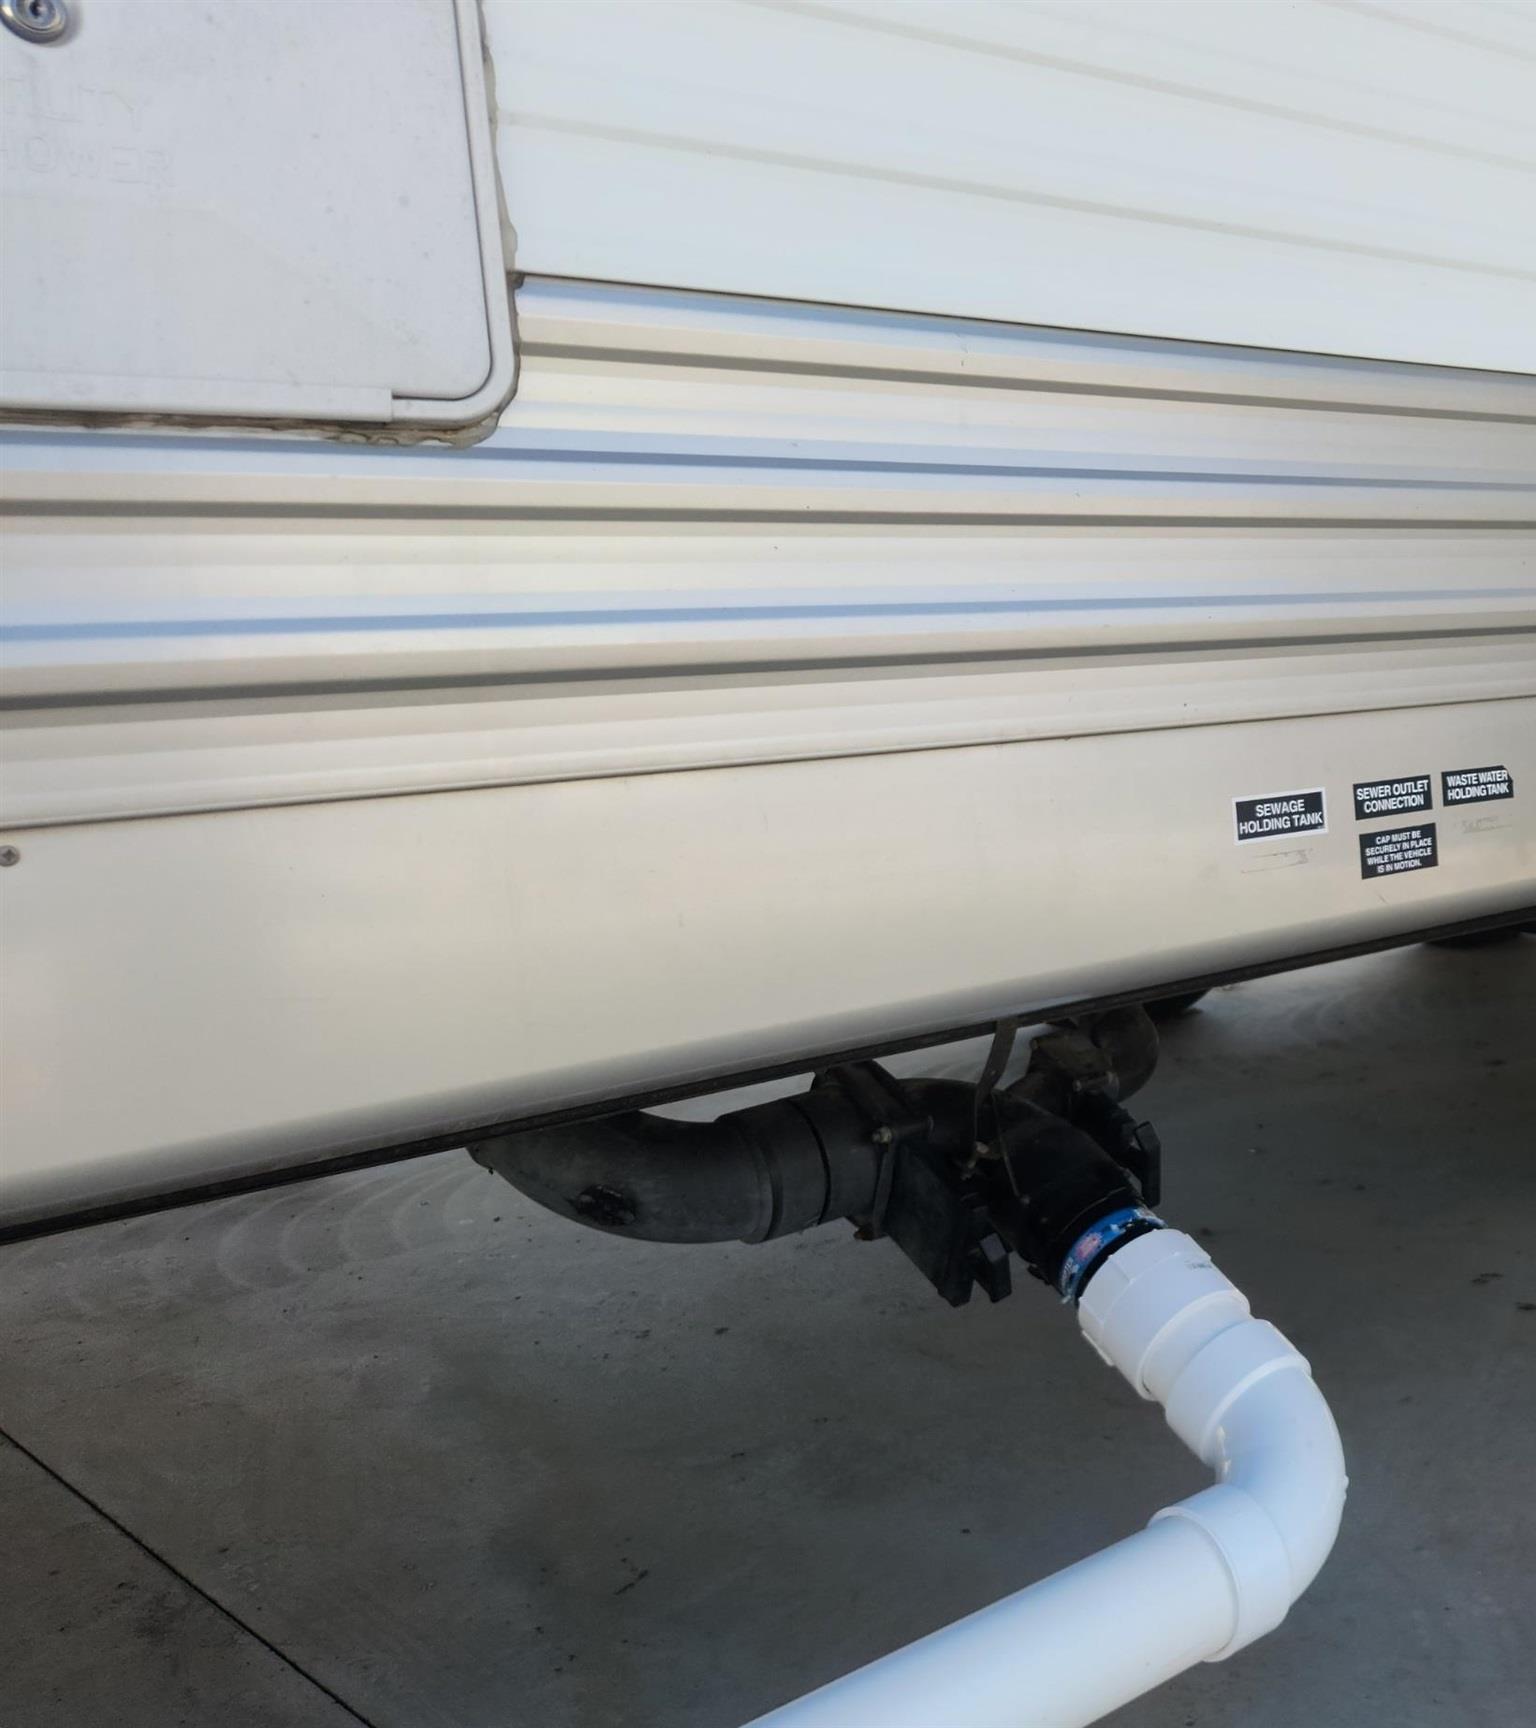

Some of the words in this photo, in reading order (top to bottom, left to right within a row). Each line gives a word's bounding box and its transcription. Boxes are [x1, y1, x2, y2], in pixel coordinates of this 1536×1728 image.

[1446, 773, 1478, 787] WASTE
[1478, 769, 1508, 784] WATER
[1356, 785, 1391, 800] SEWER
[1392, 780, 1429, 796] OUTLET
[1447, 785, 1486, 800] HOLDING
[1486, 782, 1509, 796] TANK
[1256, 799, 1305, 817] SEWAGE
[1364, 794, 1424, 813] CONNECTION
[1239, 816, 1291, 834] HOLDING
[1292, 812, 1323, 827] TANK
[1376, 835, 1391, 844] CAP
[1391, 832, 1410, 842] MUST
[1411, 830, 1421, 839] BE
[1365, 843, 1402, 856] SECURELY
[1402, 841, 1409, 849] IN
[1410, 837, 1433, 849] PLACE
[1367, 854, 1389, 865] WHILE
[1390, 851, 1403, 861] THE
[1403, 847, 1432, 859] VEHICLE
[1377, 865, 1385, 873] IS
[1386, 863, 1393, 871] IN
[1394, 859, 1422, 870] MOTION.
